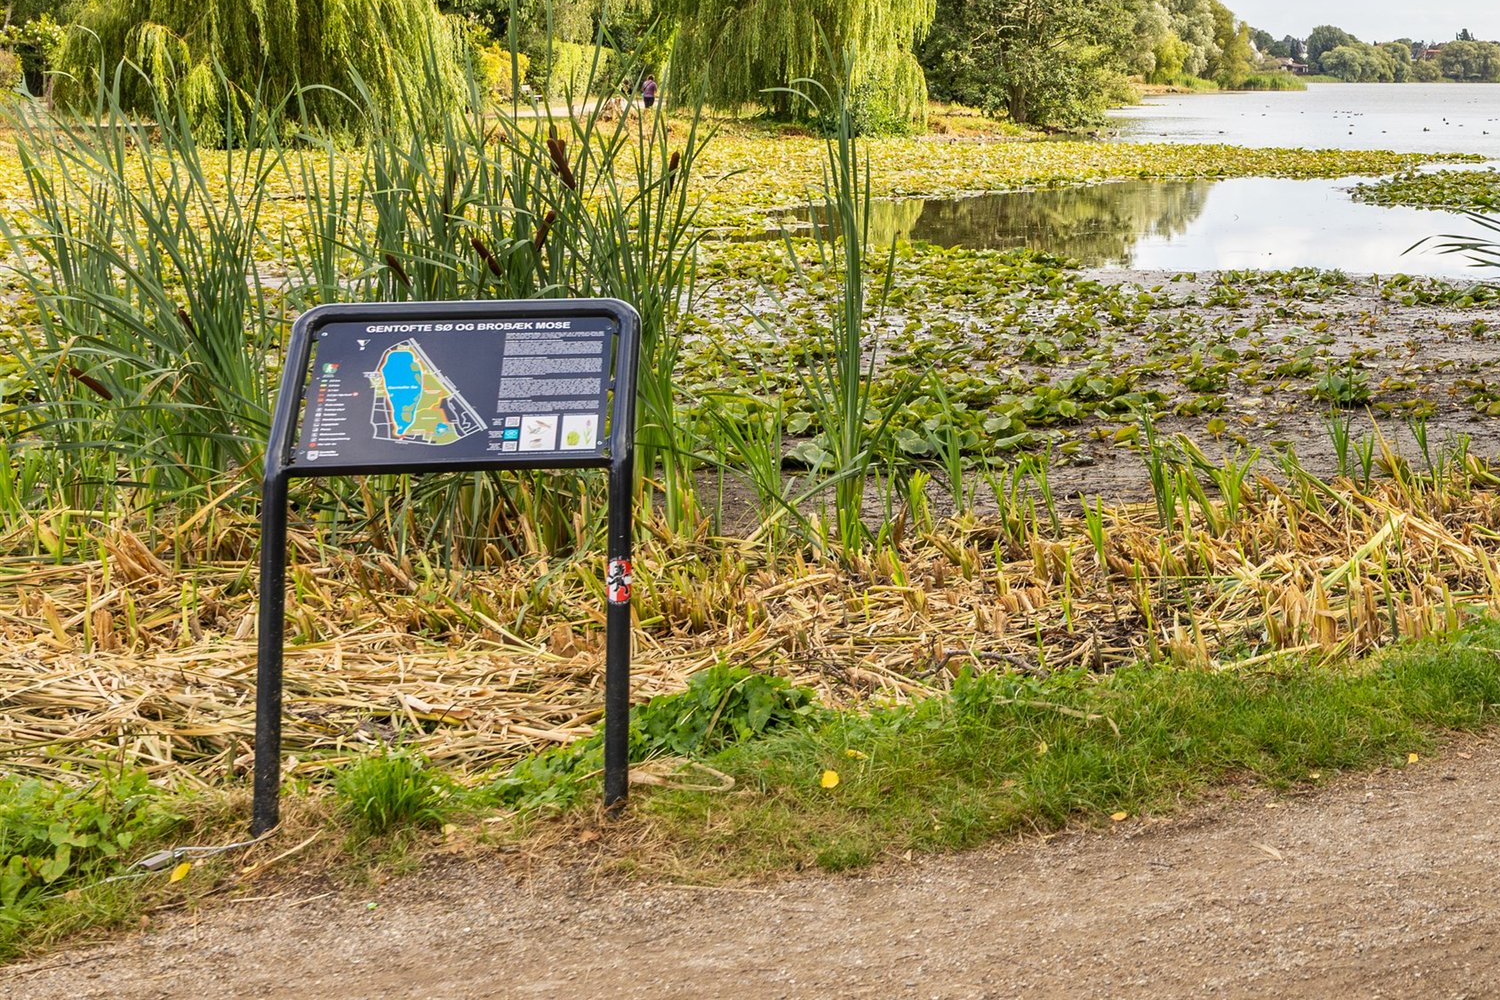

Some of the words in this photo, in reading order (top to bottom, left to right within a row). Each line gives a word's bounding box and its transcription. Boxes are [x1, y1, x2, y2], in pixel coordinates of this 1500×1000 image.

[366, 324, 432, 333] GENTOFTE
[434, 323, 453, 332] SØ
[455, 323, 475, 331] OG
[477, 322, 534, 331] BROBÆK
[535, 321, 571, 330] MOSE
